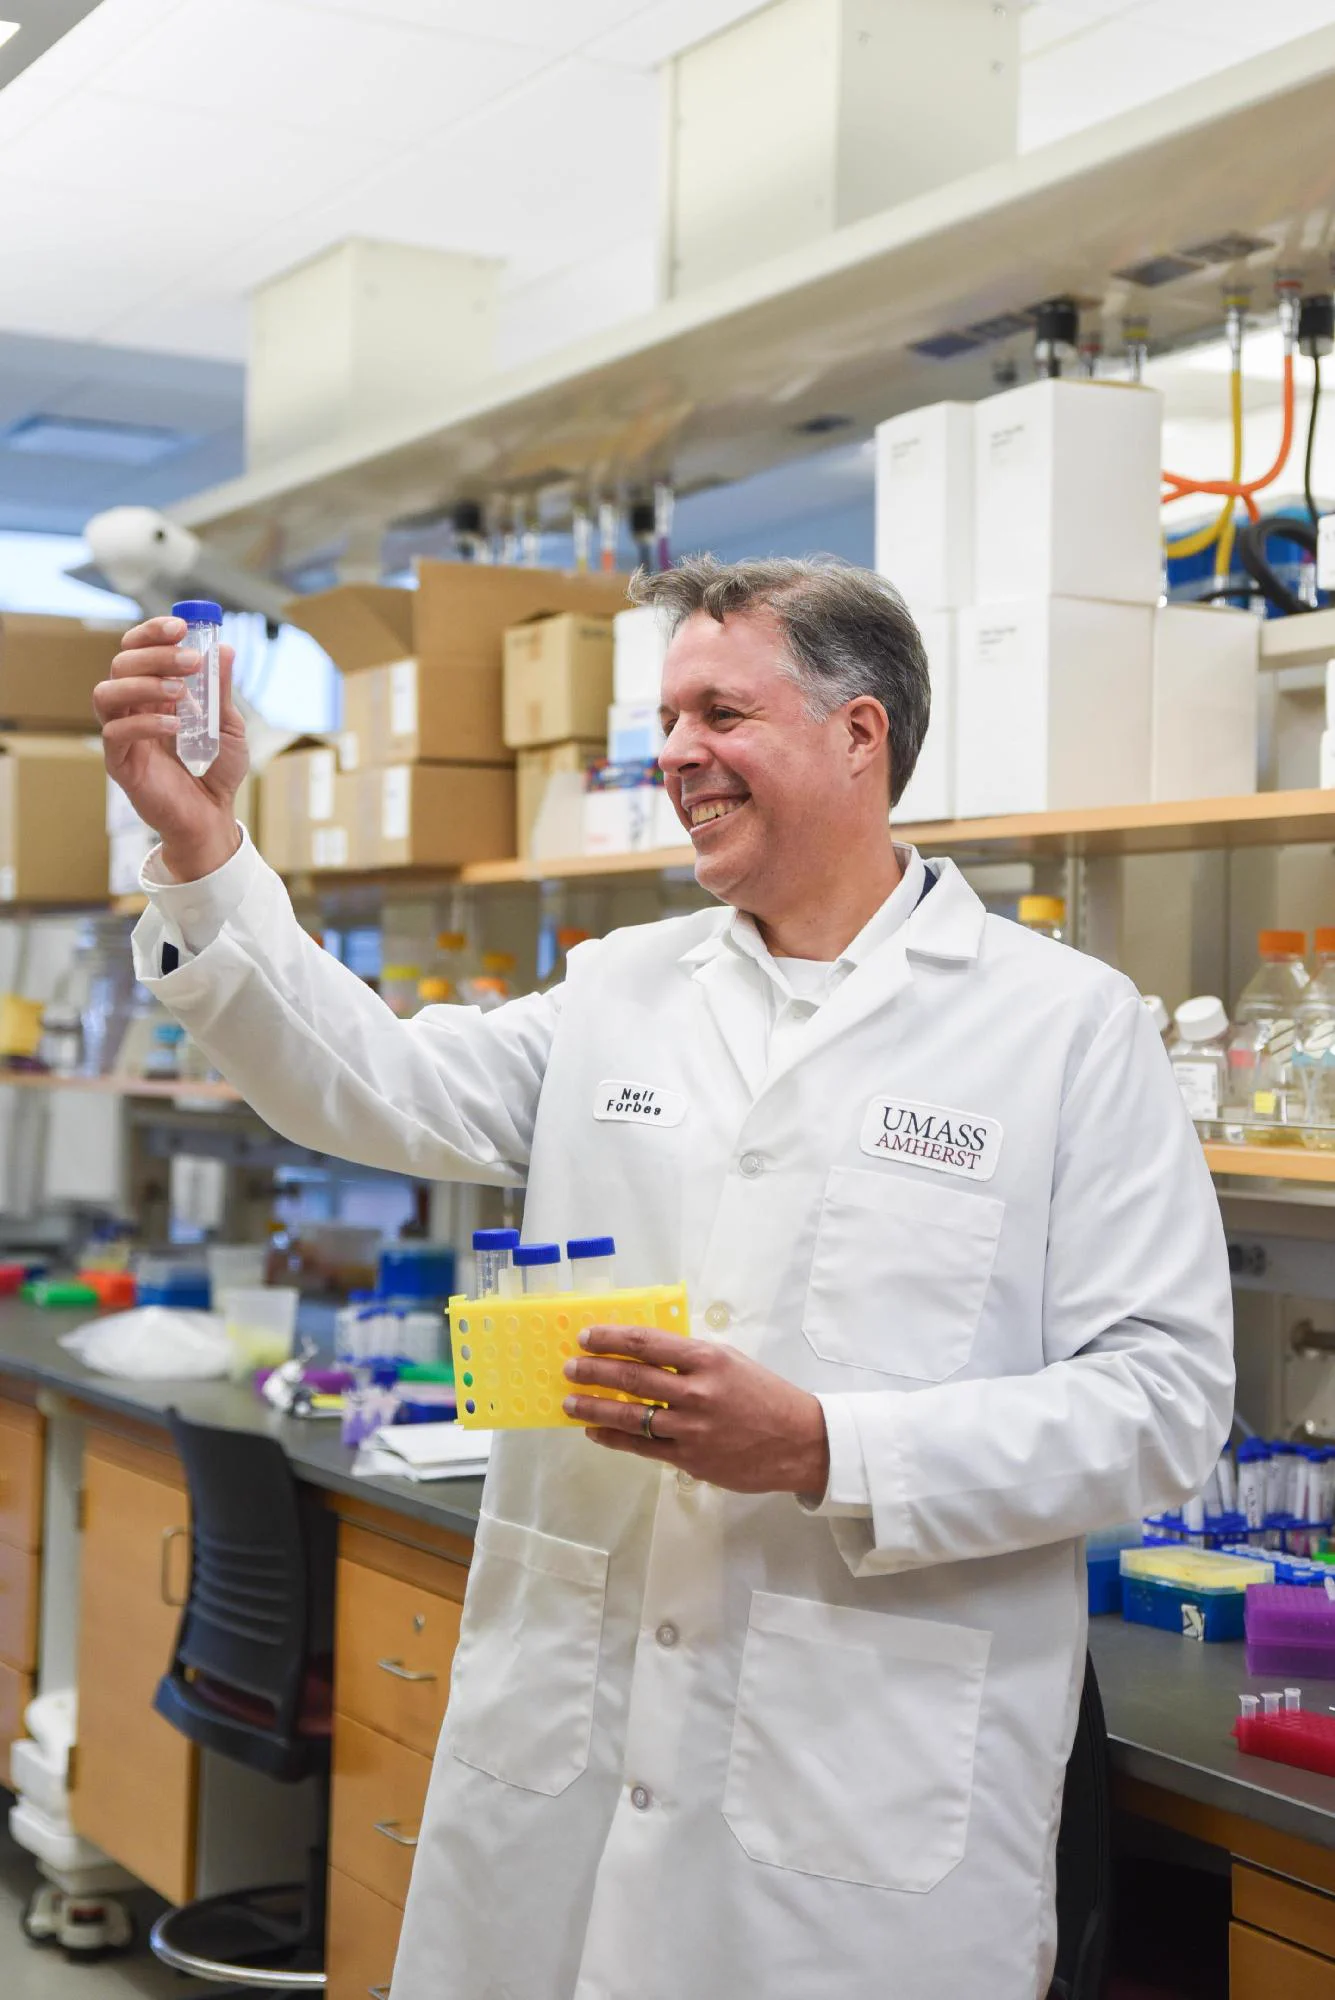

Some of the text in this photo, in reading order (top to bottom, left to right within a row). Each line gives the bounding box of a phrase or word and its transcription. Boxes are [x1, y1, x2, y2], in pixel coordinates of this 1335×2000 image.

[606, 1099, 662, 1116] Forbes
[882, 1106, 987, 1151] UMASS
[874, 1132, 981, 1170] AMHERST
